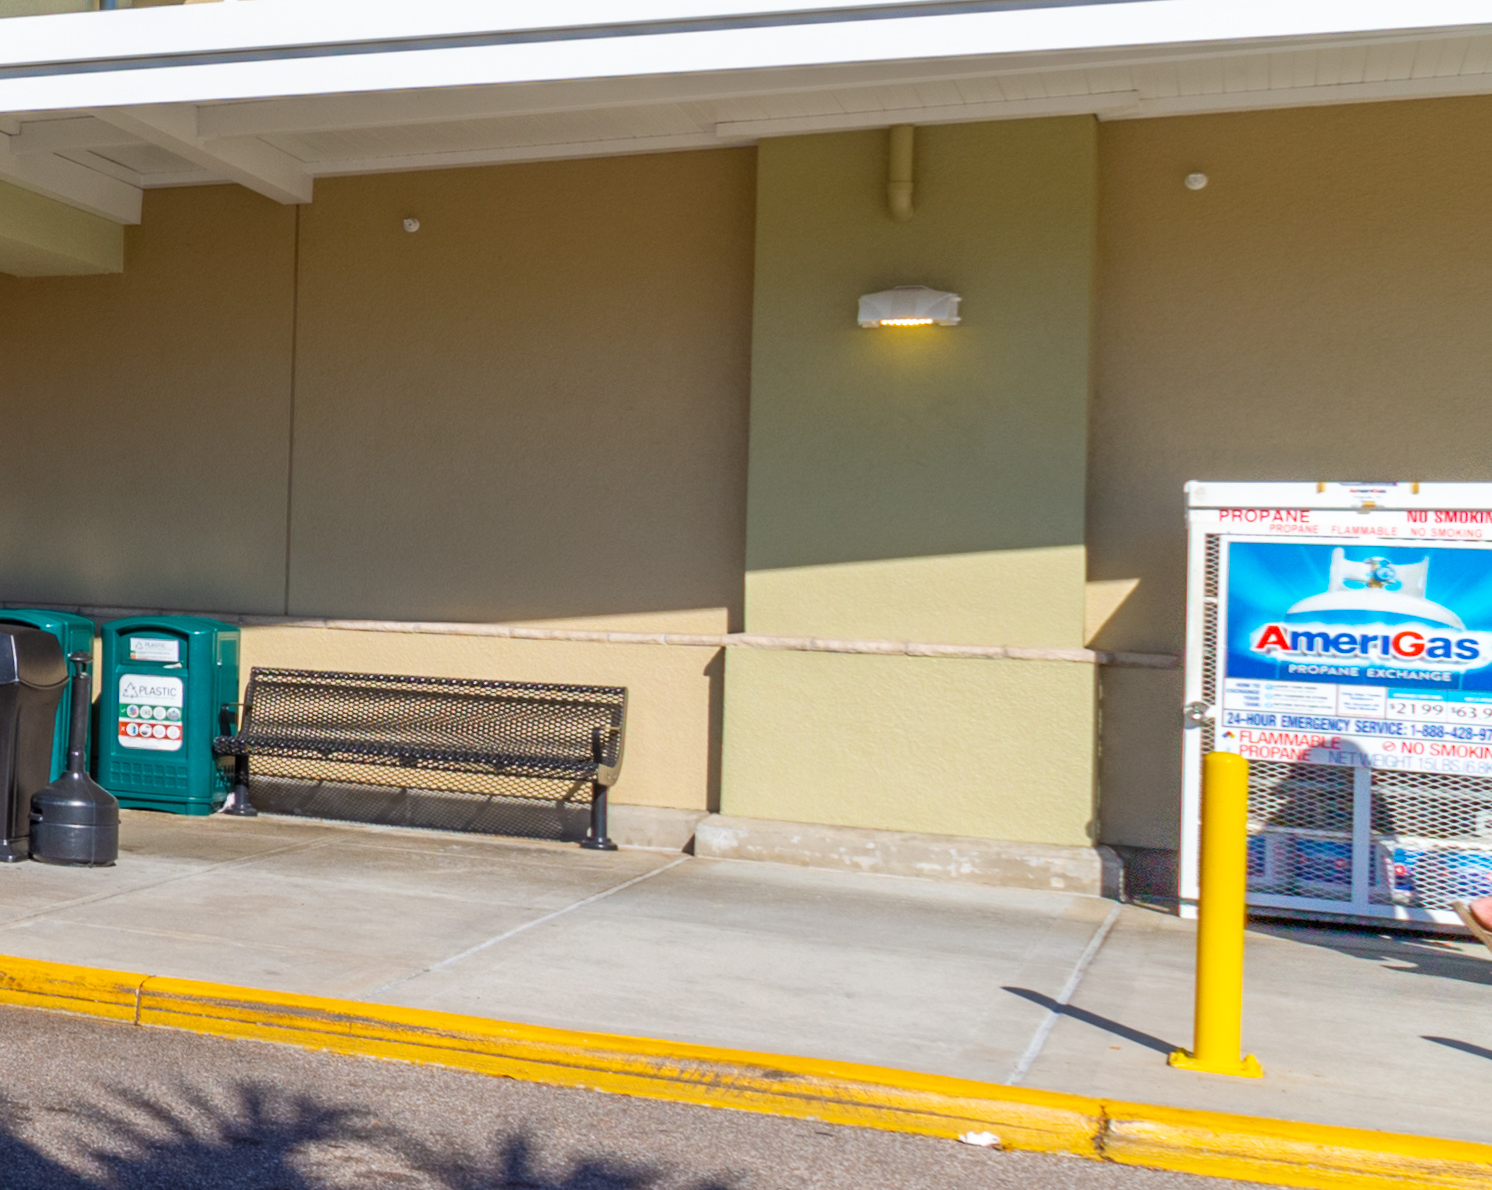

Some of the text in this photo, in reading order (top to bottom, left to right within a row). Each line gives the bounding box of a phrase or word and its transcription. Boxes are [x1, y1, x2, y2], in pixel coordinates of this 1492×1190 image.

[1219, 509, 1311, 523] PROPANE
[1407, 510, 1428, 523] NO
[1269, 524, 1483, 538] PROPANE FLAMMABLE NO SMOKING
[145, 640, 166, 648] PLASTIC
[1256, 626, 1480, 660] AmeriGas
[1288, 665, 1452, 682] PROPANE EXCHANGE
[139, 686, 177, 697] PLASTIC
[1227, 712, 1492, 742] 24-HOUR EMERGENCY SERVICE: 1-888-428-97
[1240, 730, 1492, 760] FLAMMABLE NO SMOKIN
[1240, 745, 1312, 762] PROPANE
